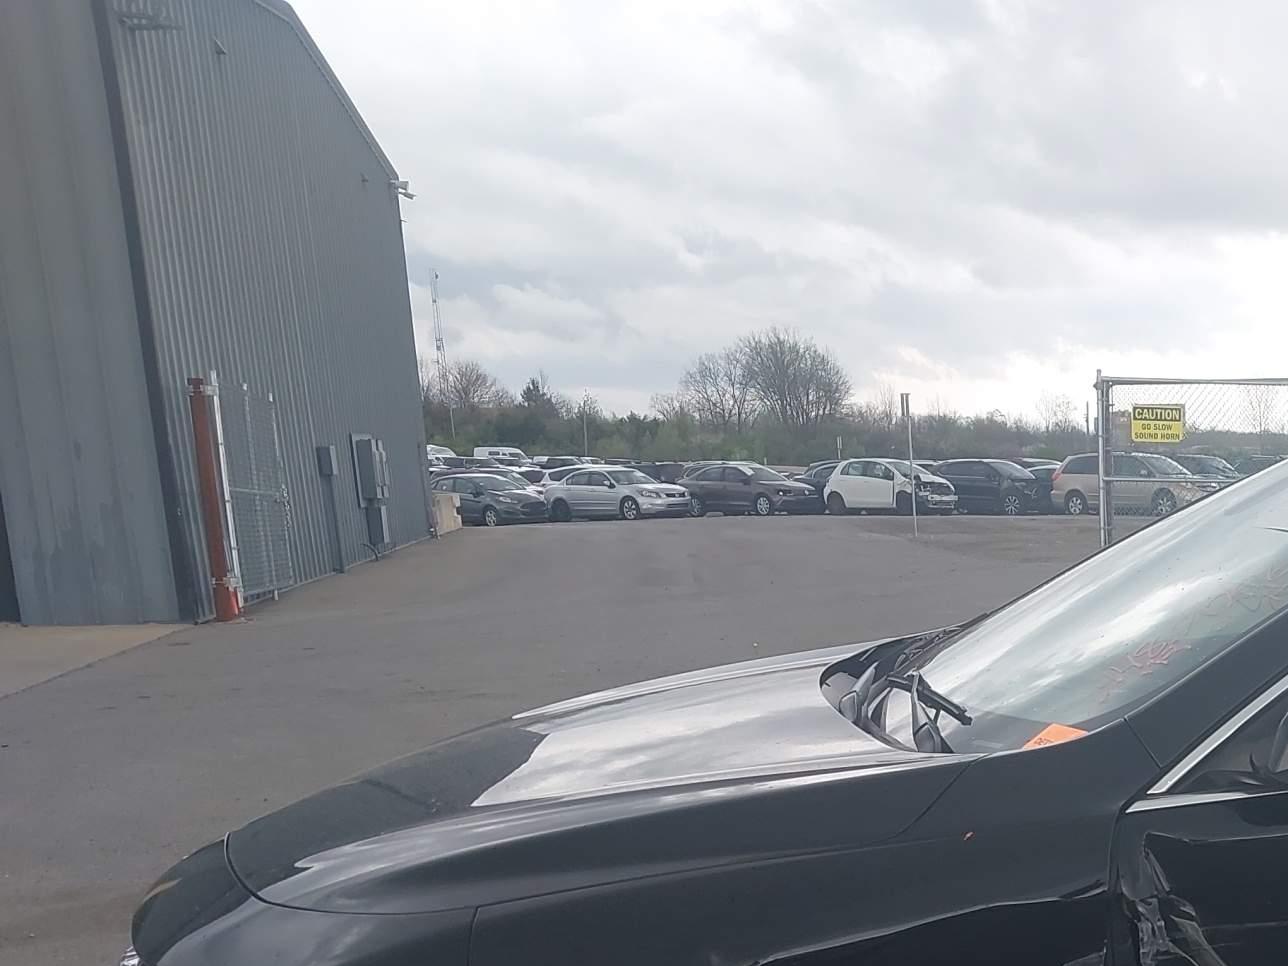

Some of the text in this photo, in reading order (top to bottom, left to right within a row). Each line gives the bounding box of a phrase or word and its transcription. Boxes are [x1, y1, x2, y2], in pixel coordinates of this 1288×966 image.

[1134, 408, 1180, 420] CAUTION
[1141, 423, 1173, 431] GO SLOW
[1134, 431, 1180, 441] SOUND HORN
